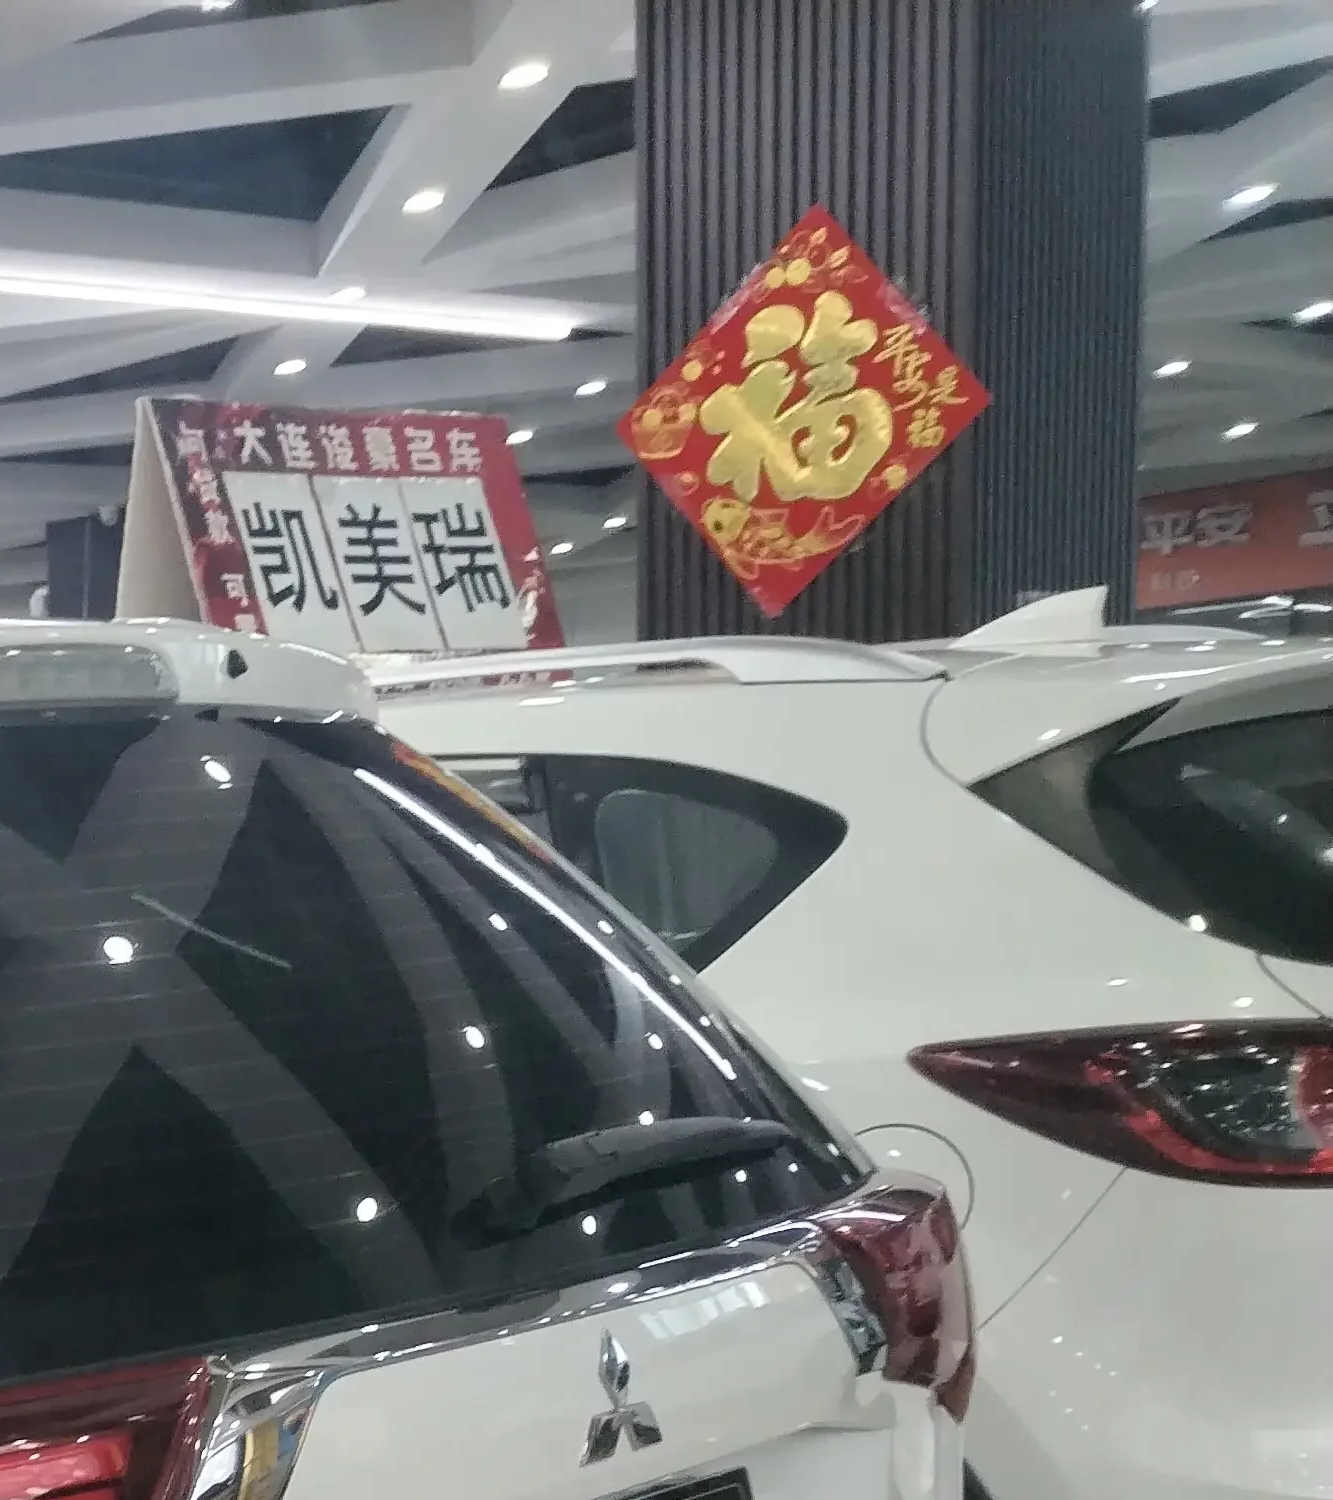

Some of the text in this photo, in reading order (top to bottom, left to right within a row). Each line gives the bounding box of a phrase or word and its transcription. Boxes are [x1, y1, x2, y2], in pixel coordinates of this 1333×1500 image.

[699, 290, 893, 501] 福
[240, 501, 511, 617] 凯美瑞
